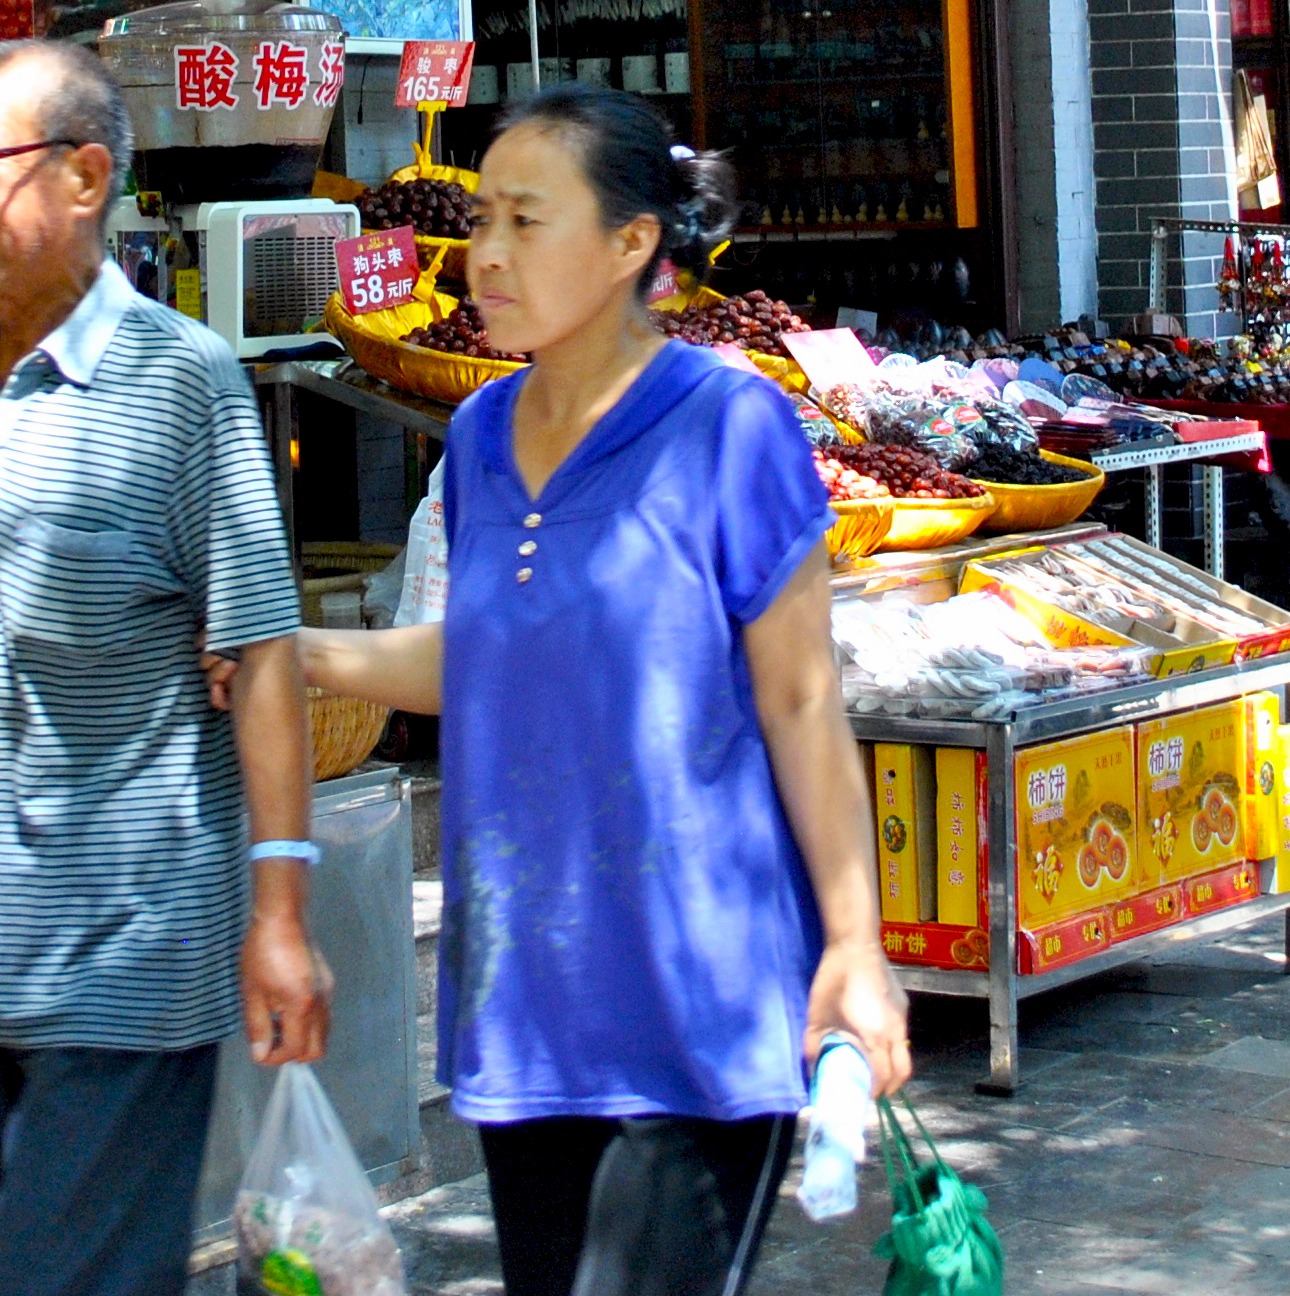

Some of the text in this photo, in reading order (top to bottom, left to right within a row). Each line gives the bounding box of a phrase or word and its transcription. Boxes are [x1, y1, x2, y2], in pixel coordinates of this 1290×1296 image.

[174, 41, 346, 112] 酸梅汤
[403, 75, 463, 101] 165 元/斤
[352, 247, 405, 275] 狗头枣
[350, 274, 414, 308] 58 元/斤
[1149, 736, 1184, 774] 柿饼
[1028, 763, 1067, 806] 柿饼
[1031, 804, 1064, 826] SHIBING
[1152, 811, 1179, 861] 福
[1033, 845, 1060, 898] 福
[882, 929, 928, 956] 柿饼
